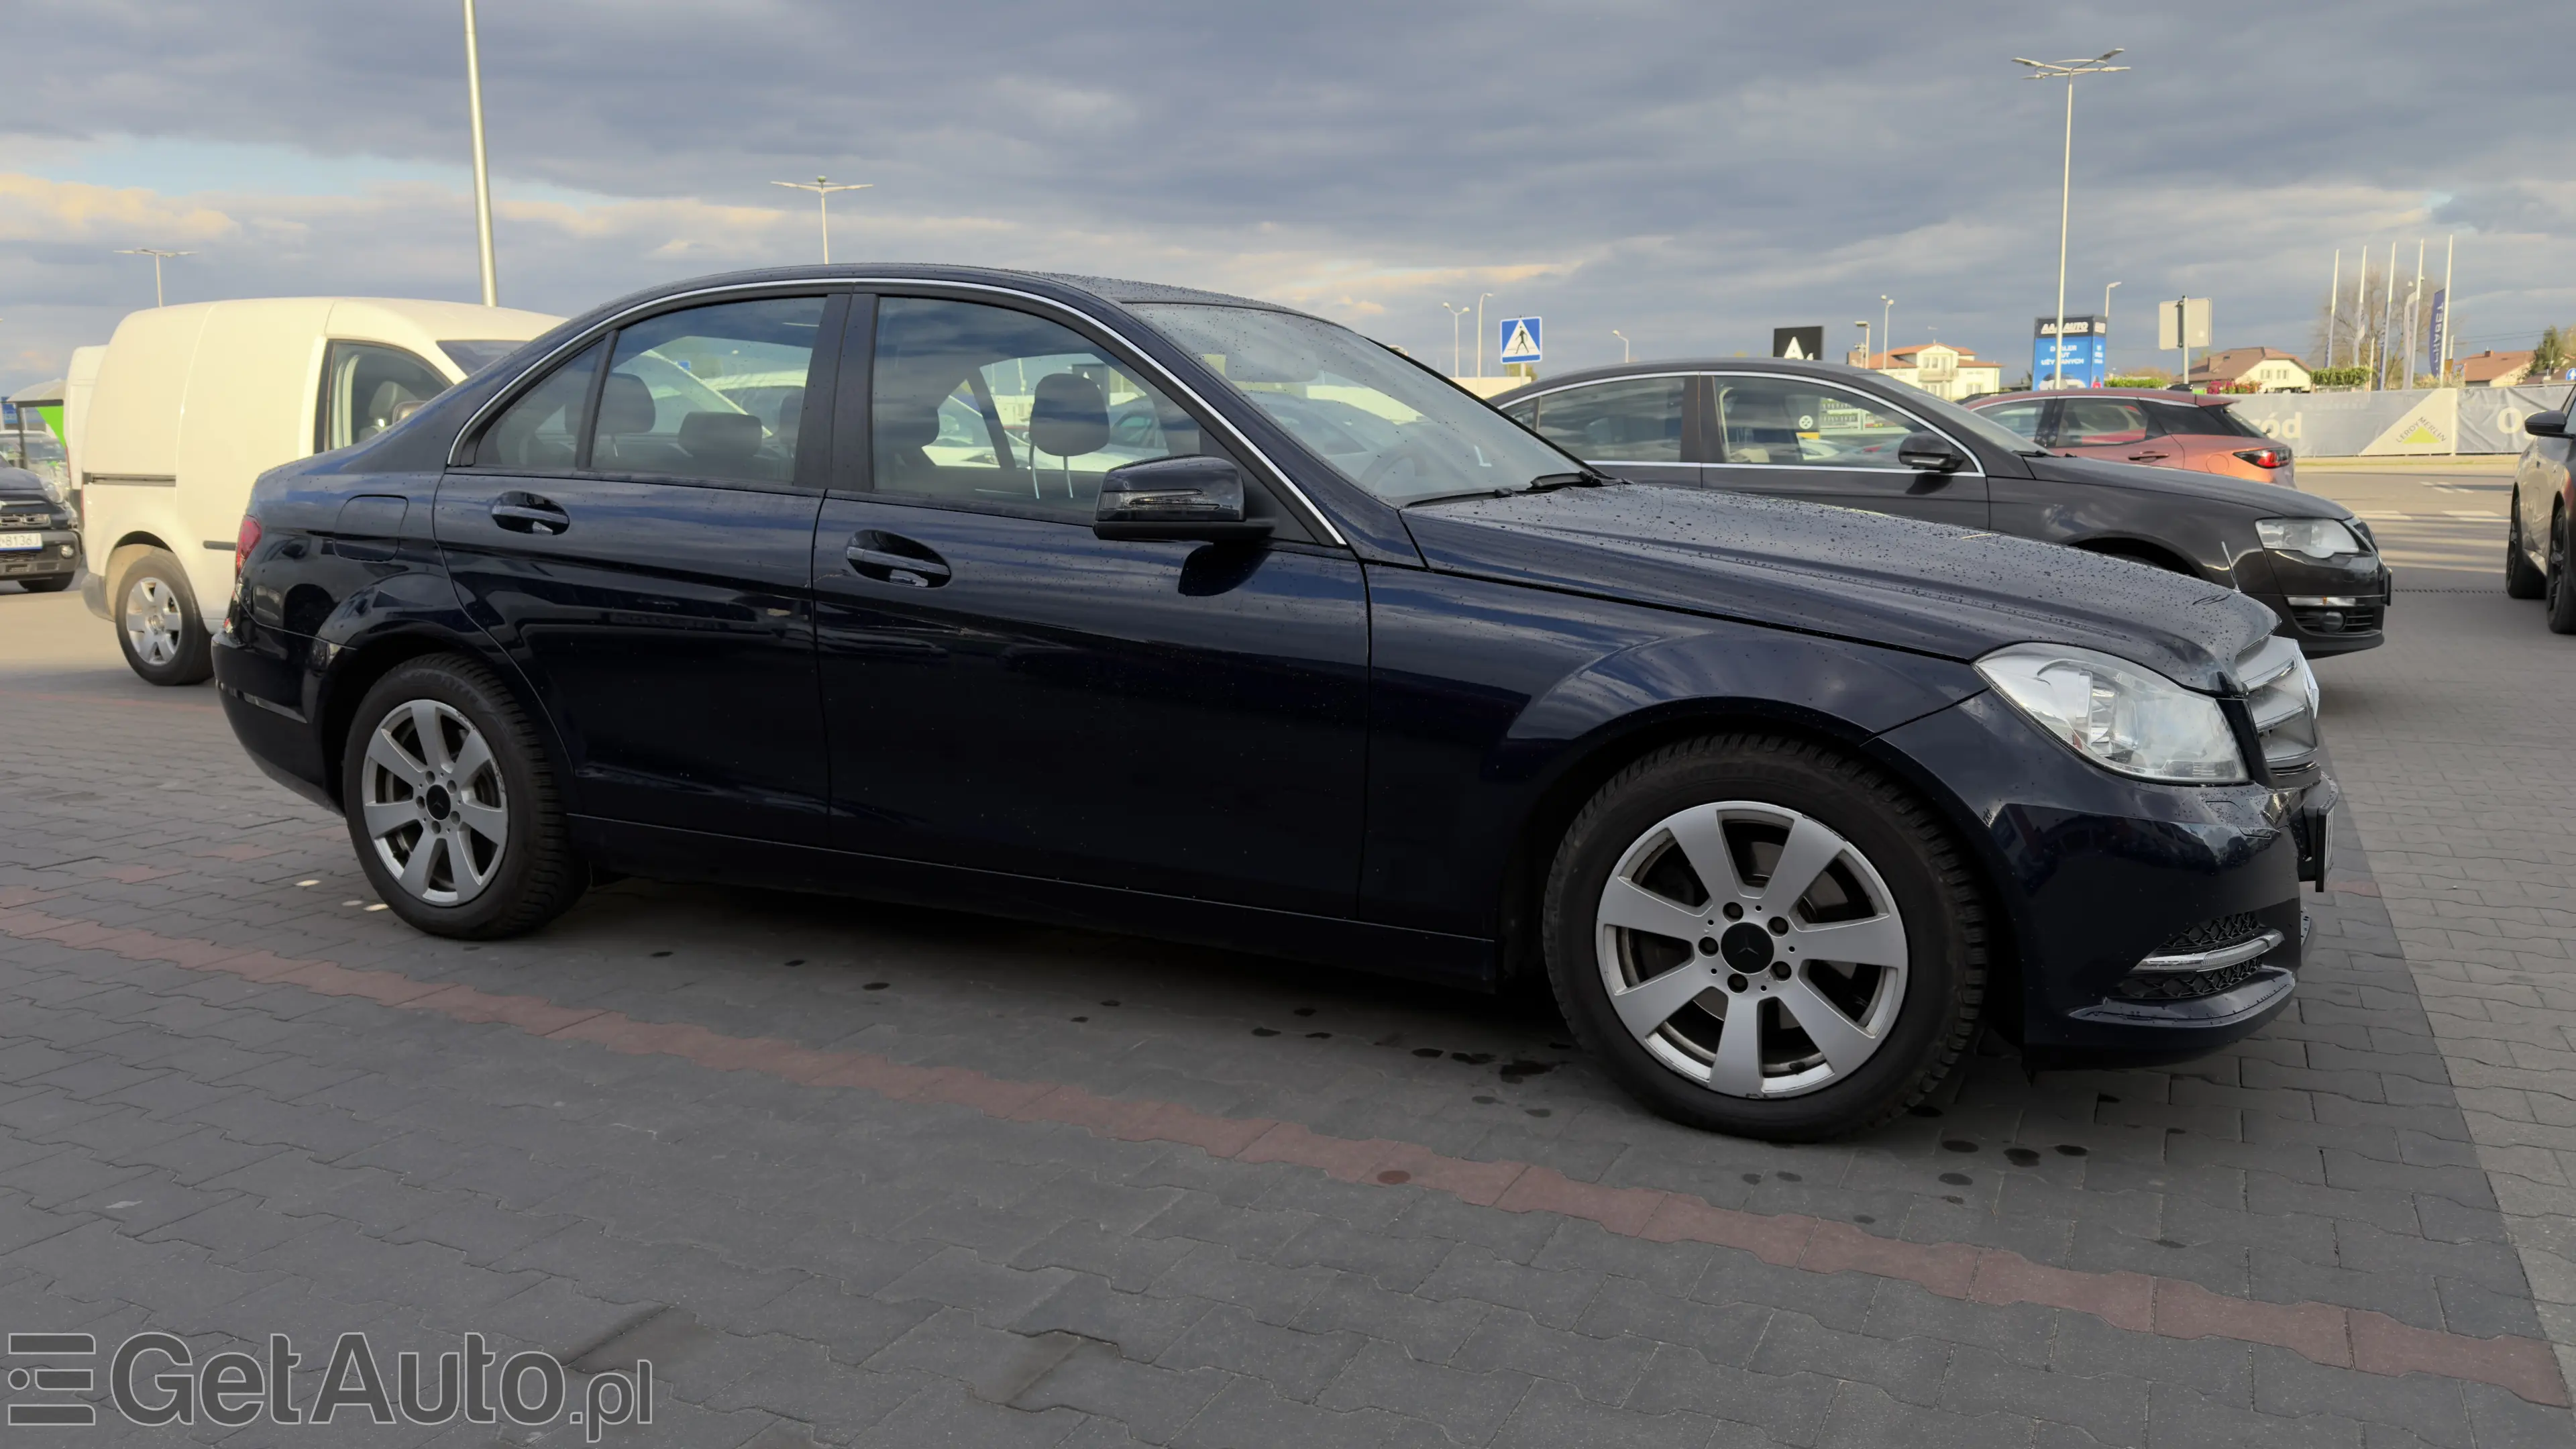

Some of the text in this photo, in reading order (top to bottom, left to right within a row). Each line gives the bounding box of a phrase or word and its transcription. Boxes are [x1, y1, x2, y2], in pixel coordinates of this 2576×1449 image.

[2041, 323, 2058, 334] AA
[2396, 416, 2447, 443] LEROY MERLIN
